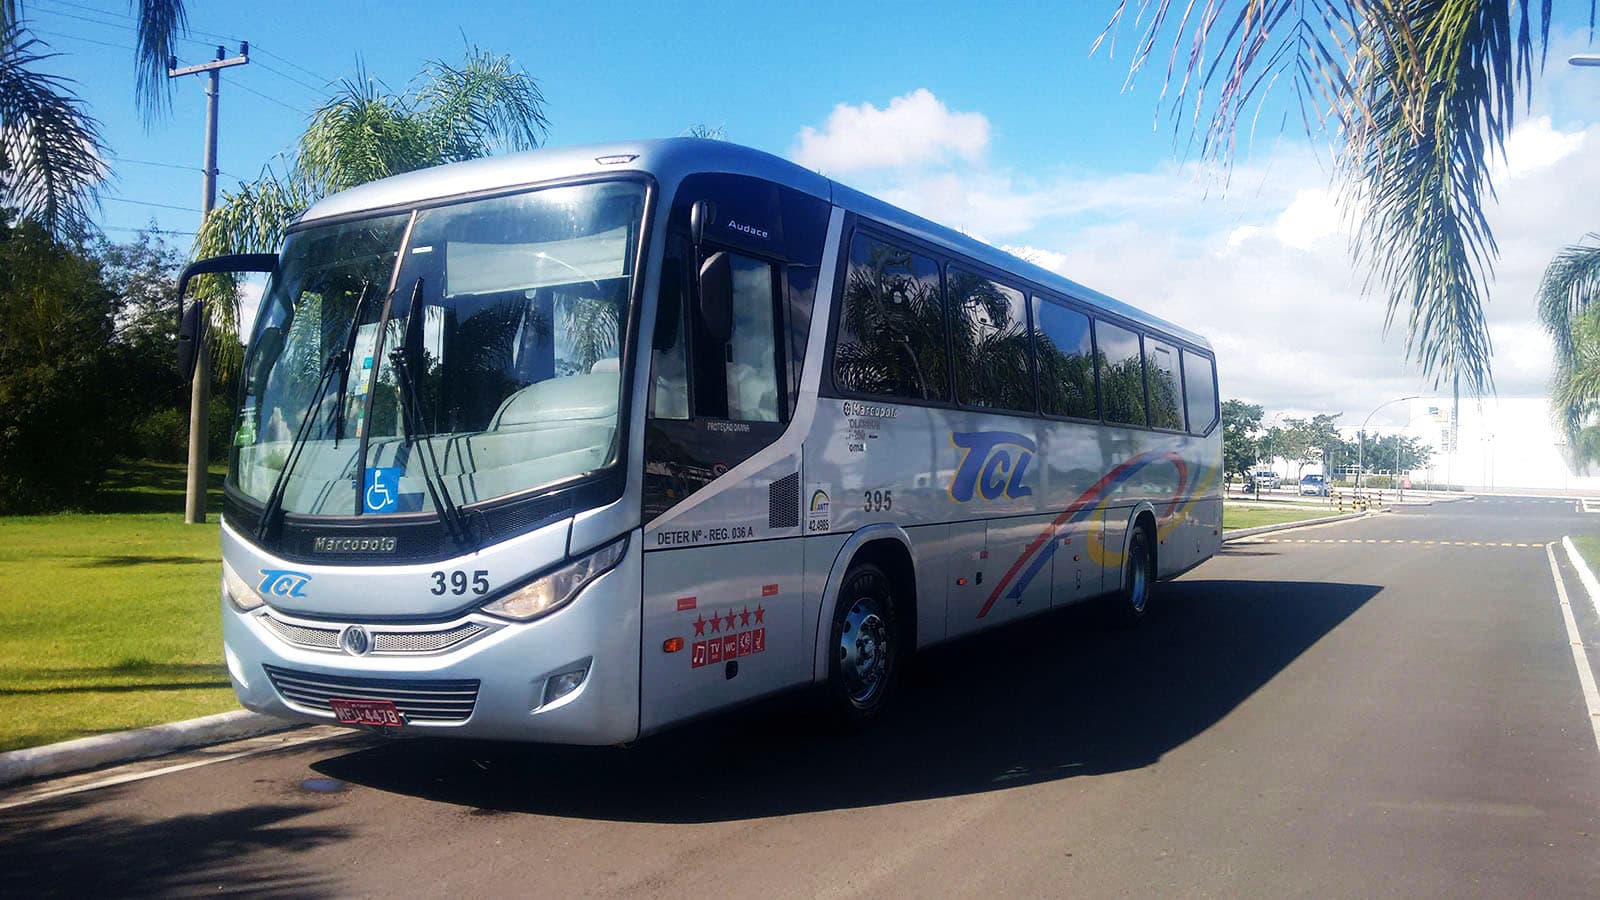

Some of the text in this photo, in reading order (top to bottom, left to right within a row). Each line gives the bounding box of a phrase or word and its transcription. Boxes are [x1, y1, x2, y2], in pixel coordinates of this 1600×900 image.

[728, 219, 768, 238] Audace
[948, 431, 1036, 504] TCL
[817, 503, 829, 511] ANTT
[864, 490, 892, 512] 395
[315, 537, 395, 551] Marcopolo
[658, 530, 690, 545] DETER
[709, 528, 730, 541] REG.
[732, 527, 746, 539] 036
[747, 526, 754, 537] A
[256, 569, 312, 598] TCL
[430, 570, 490, 596] 395
[711, 643, 720, 653] TV
[725, 642, 736, 653] WC
